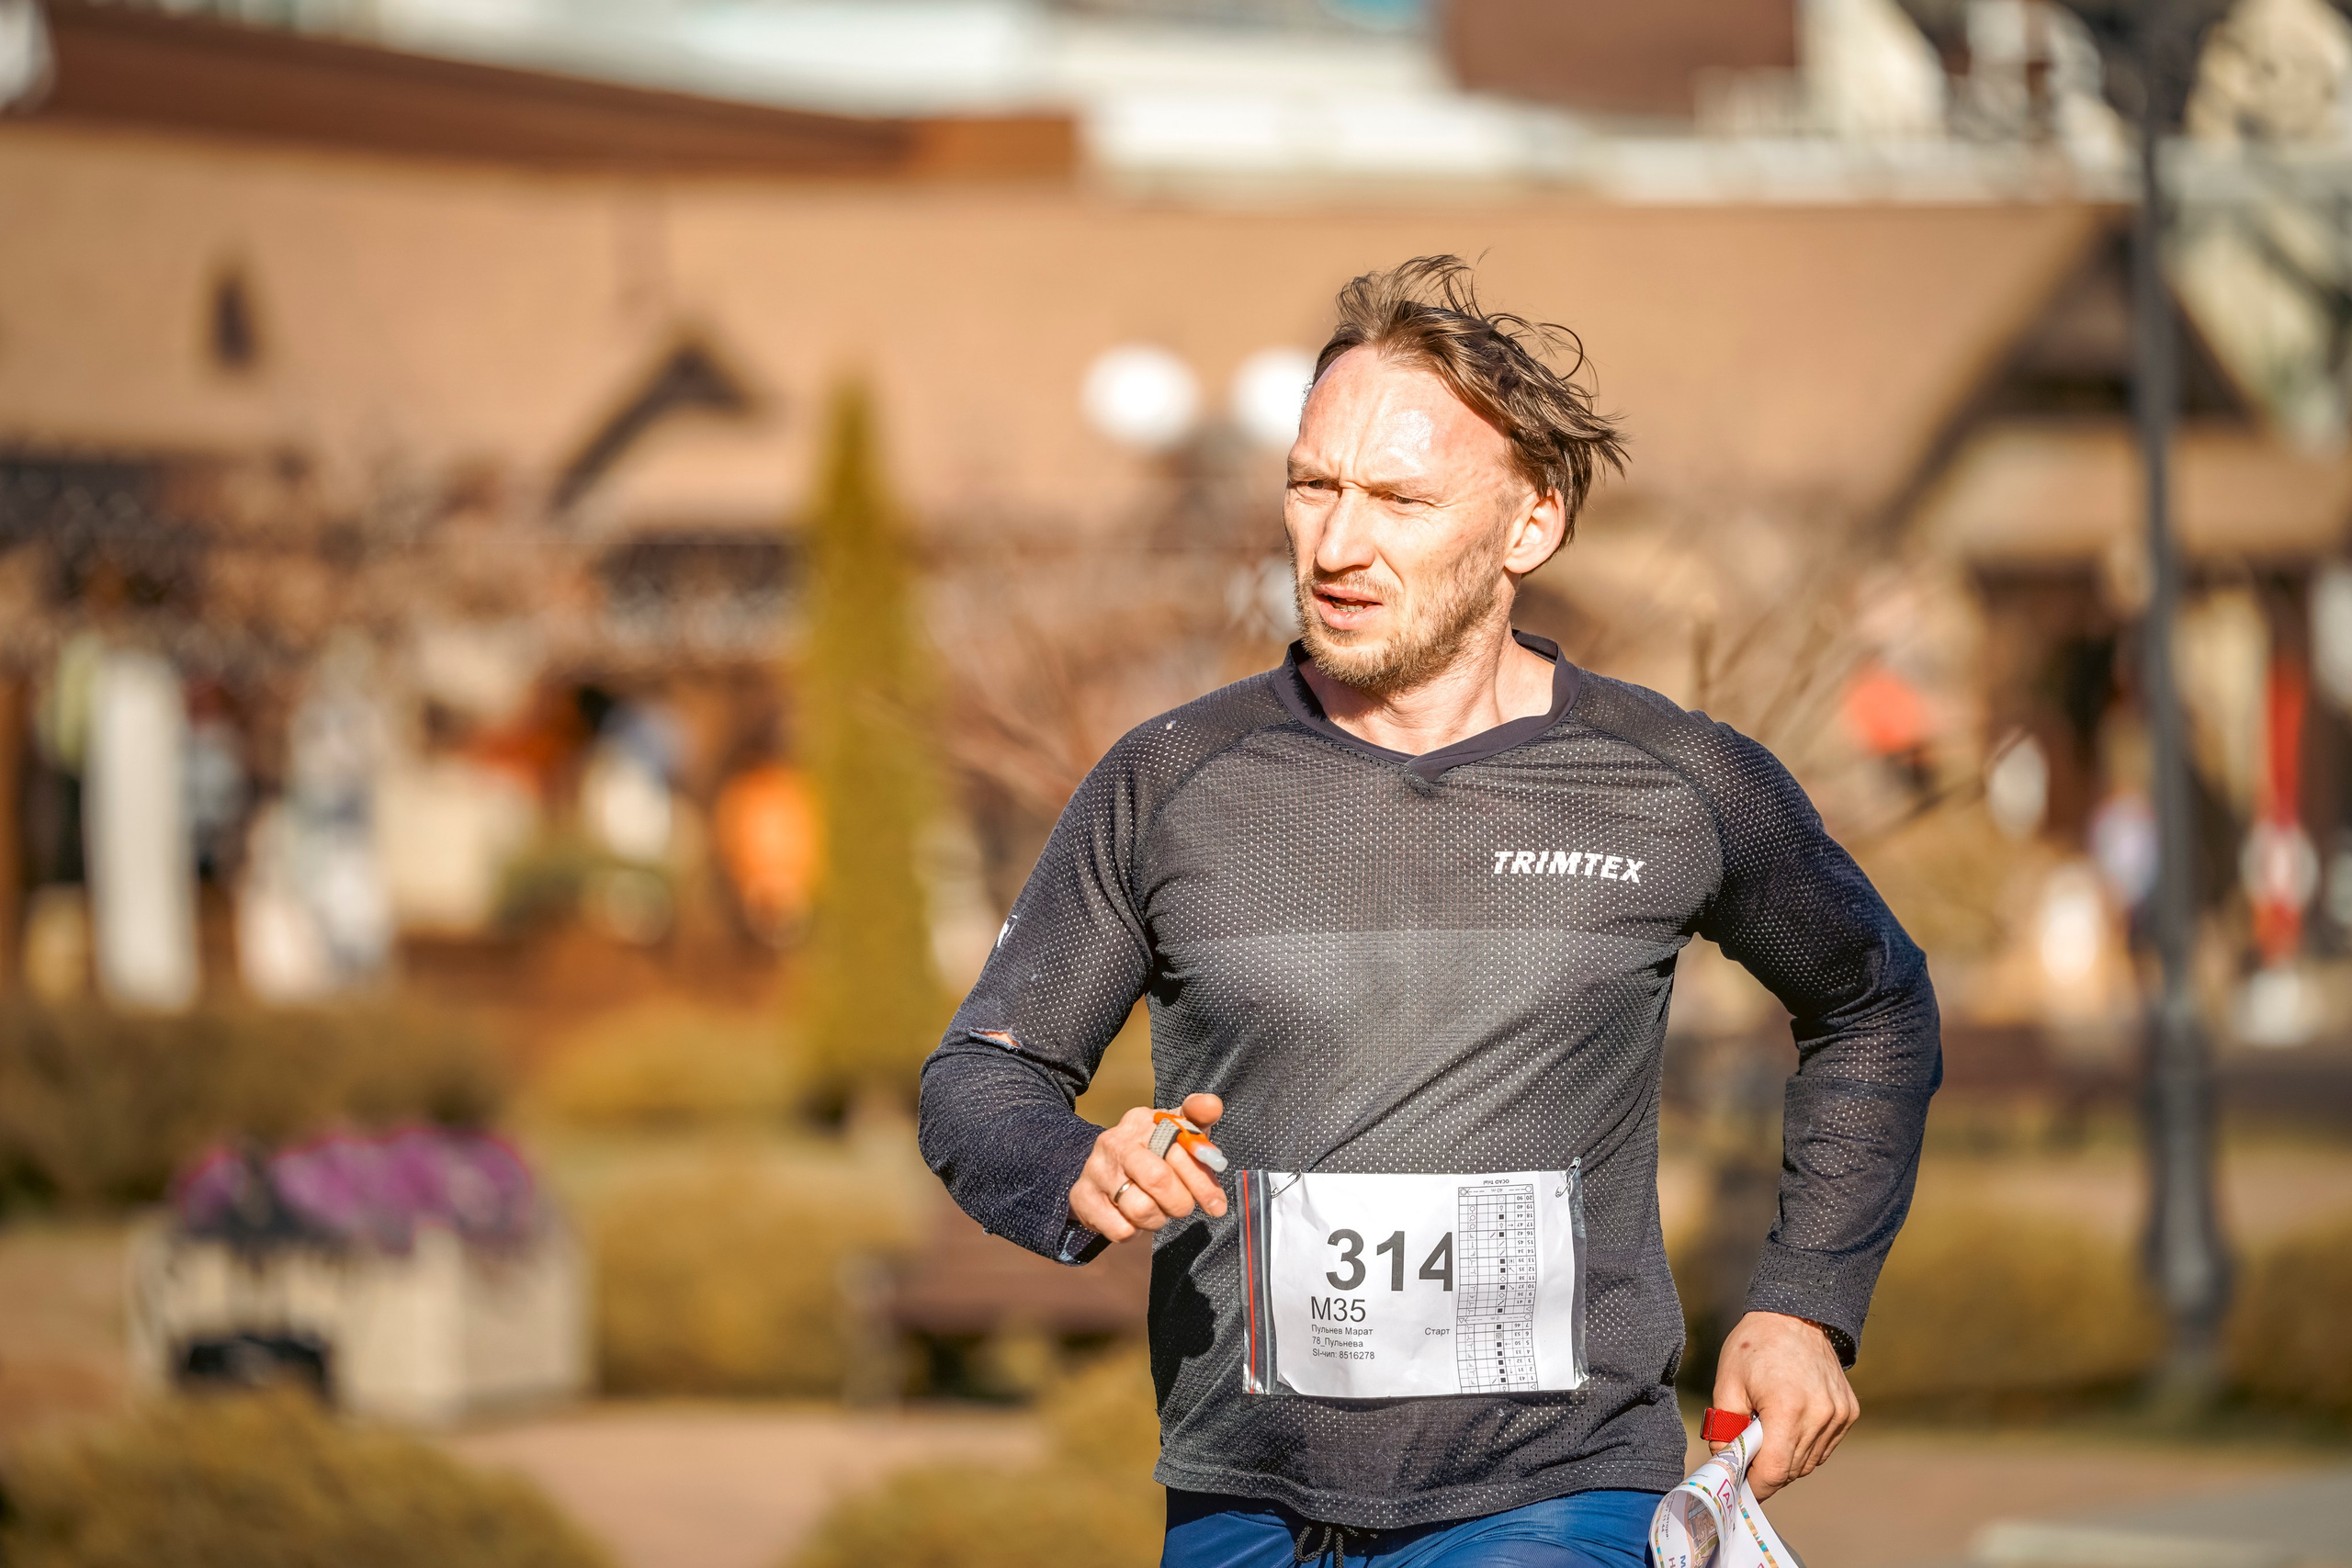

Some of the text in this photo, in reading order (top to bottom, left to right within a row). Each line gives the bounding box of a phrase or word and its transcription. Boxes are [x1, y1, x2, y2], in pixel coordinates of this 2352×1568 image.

[1494, 851, 1645, 884] TRIMTEX
[1326, 1229, 1453, 1292] 314
[1311, 1296, 1366, 1323] М35
[1312, 1325, 1373, 1337] Пульнев Марат
[1425, 1327, 1450, 1337] Старт
[1312, 1337, 1363, 1348] 78_Пульнева
[1312, 1349, 1375, 1360] SI-чип: 8516278
